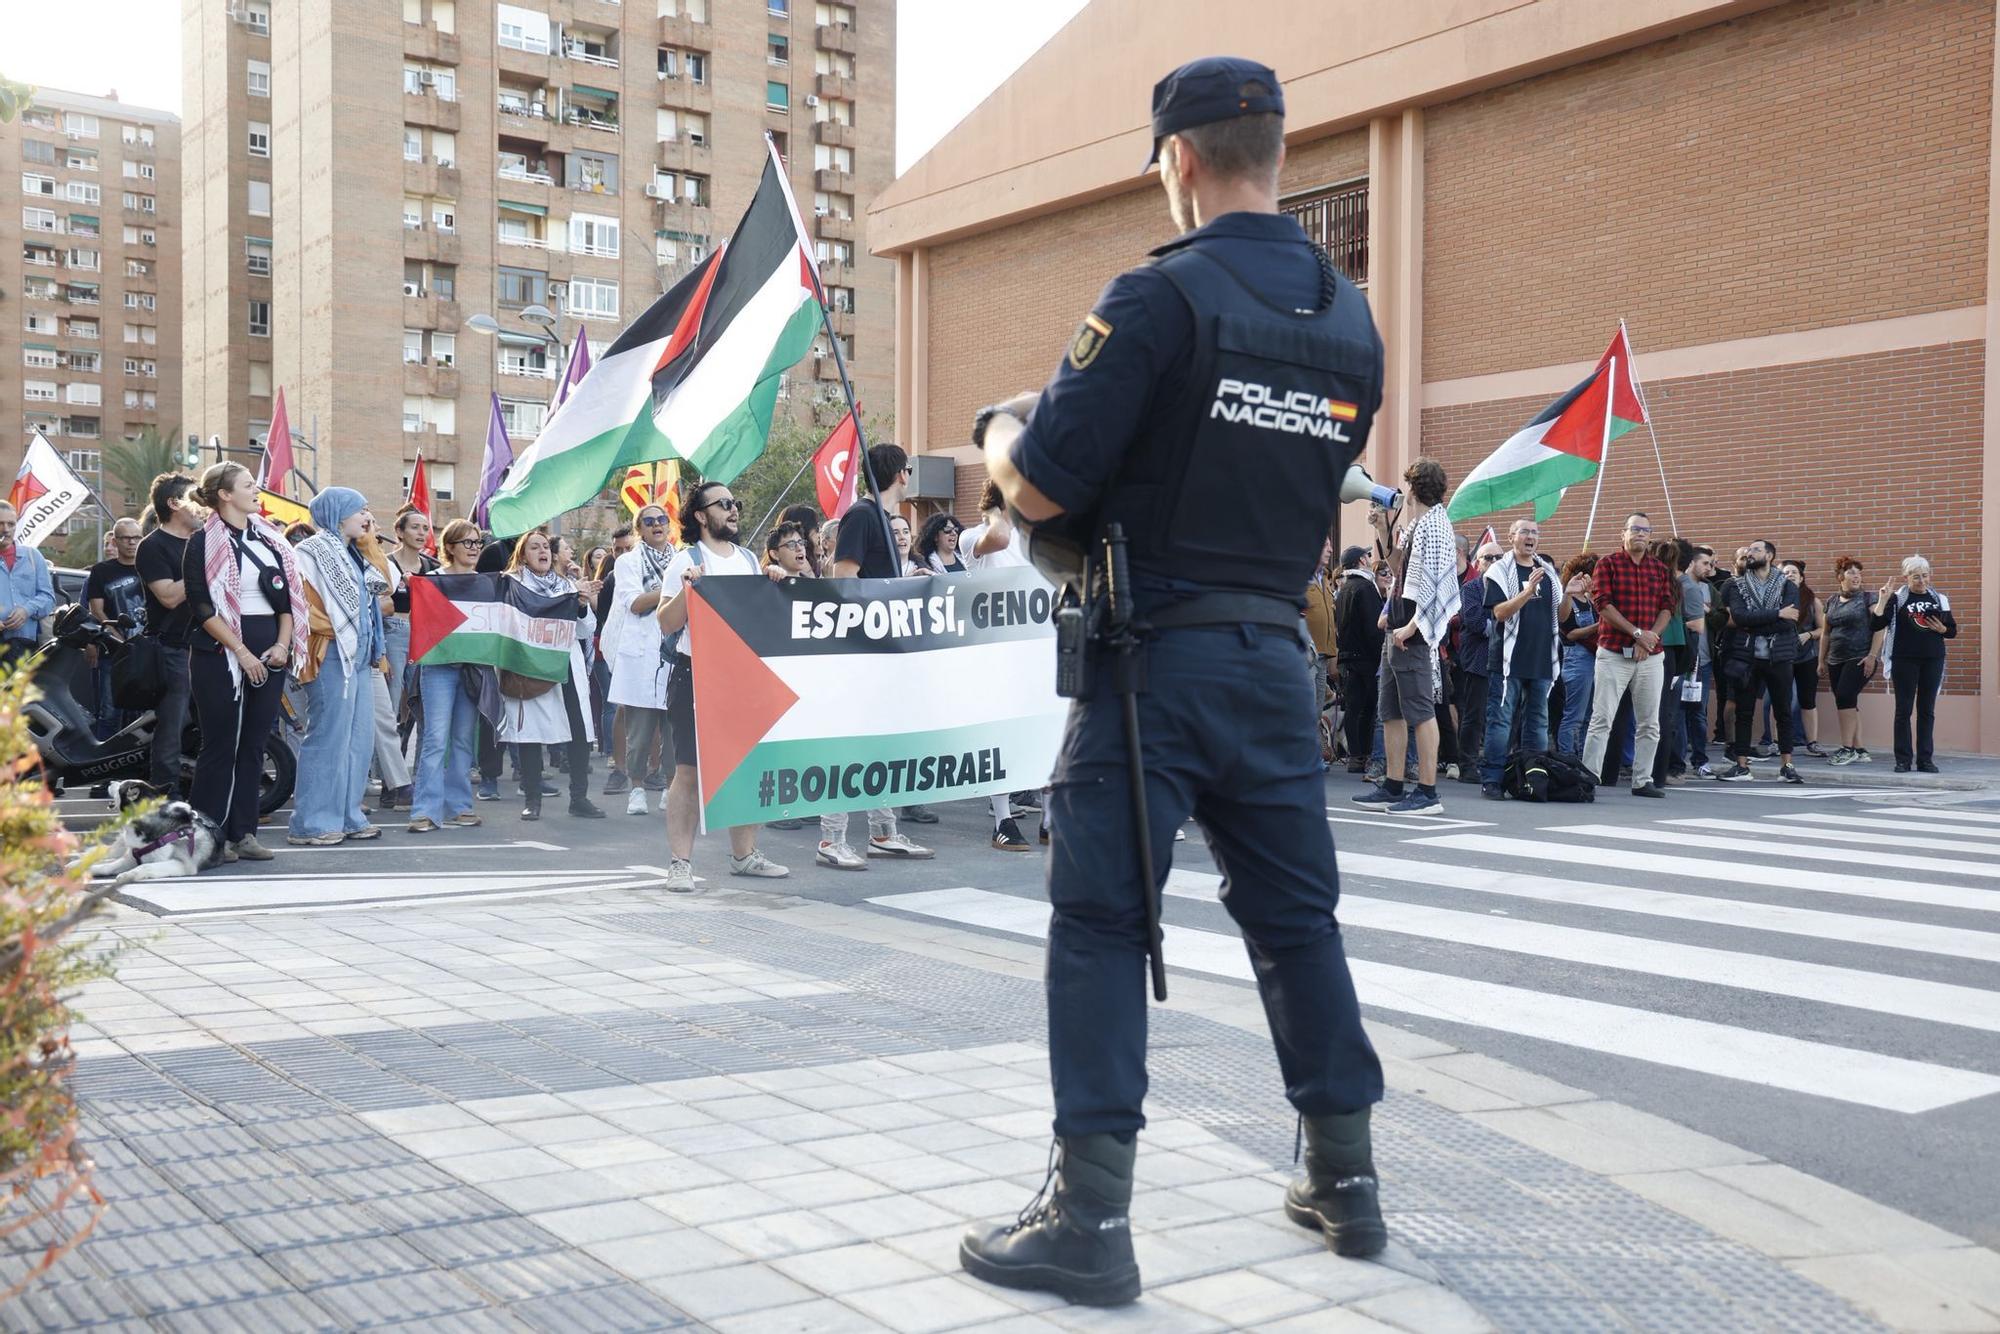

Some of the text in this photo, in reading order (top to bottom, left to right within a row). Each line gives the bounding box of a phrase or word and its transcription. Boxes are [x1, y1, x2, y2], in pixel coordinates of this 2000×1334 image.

[1216, 378, 1332, 417] POLICIA
[1210, 399, 1351, 443] NACIONAL
[791, 585, 1059, 640] ESPORT SÍ, GENO
[80, 750, 145, 777] PEUGEOT
[758, 747, 1006, 807] #BOICOTISRAEL
